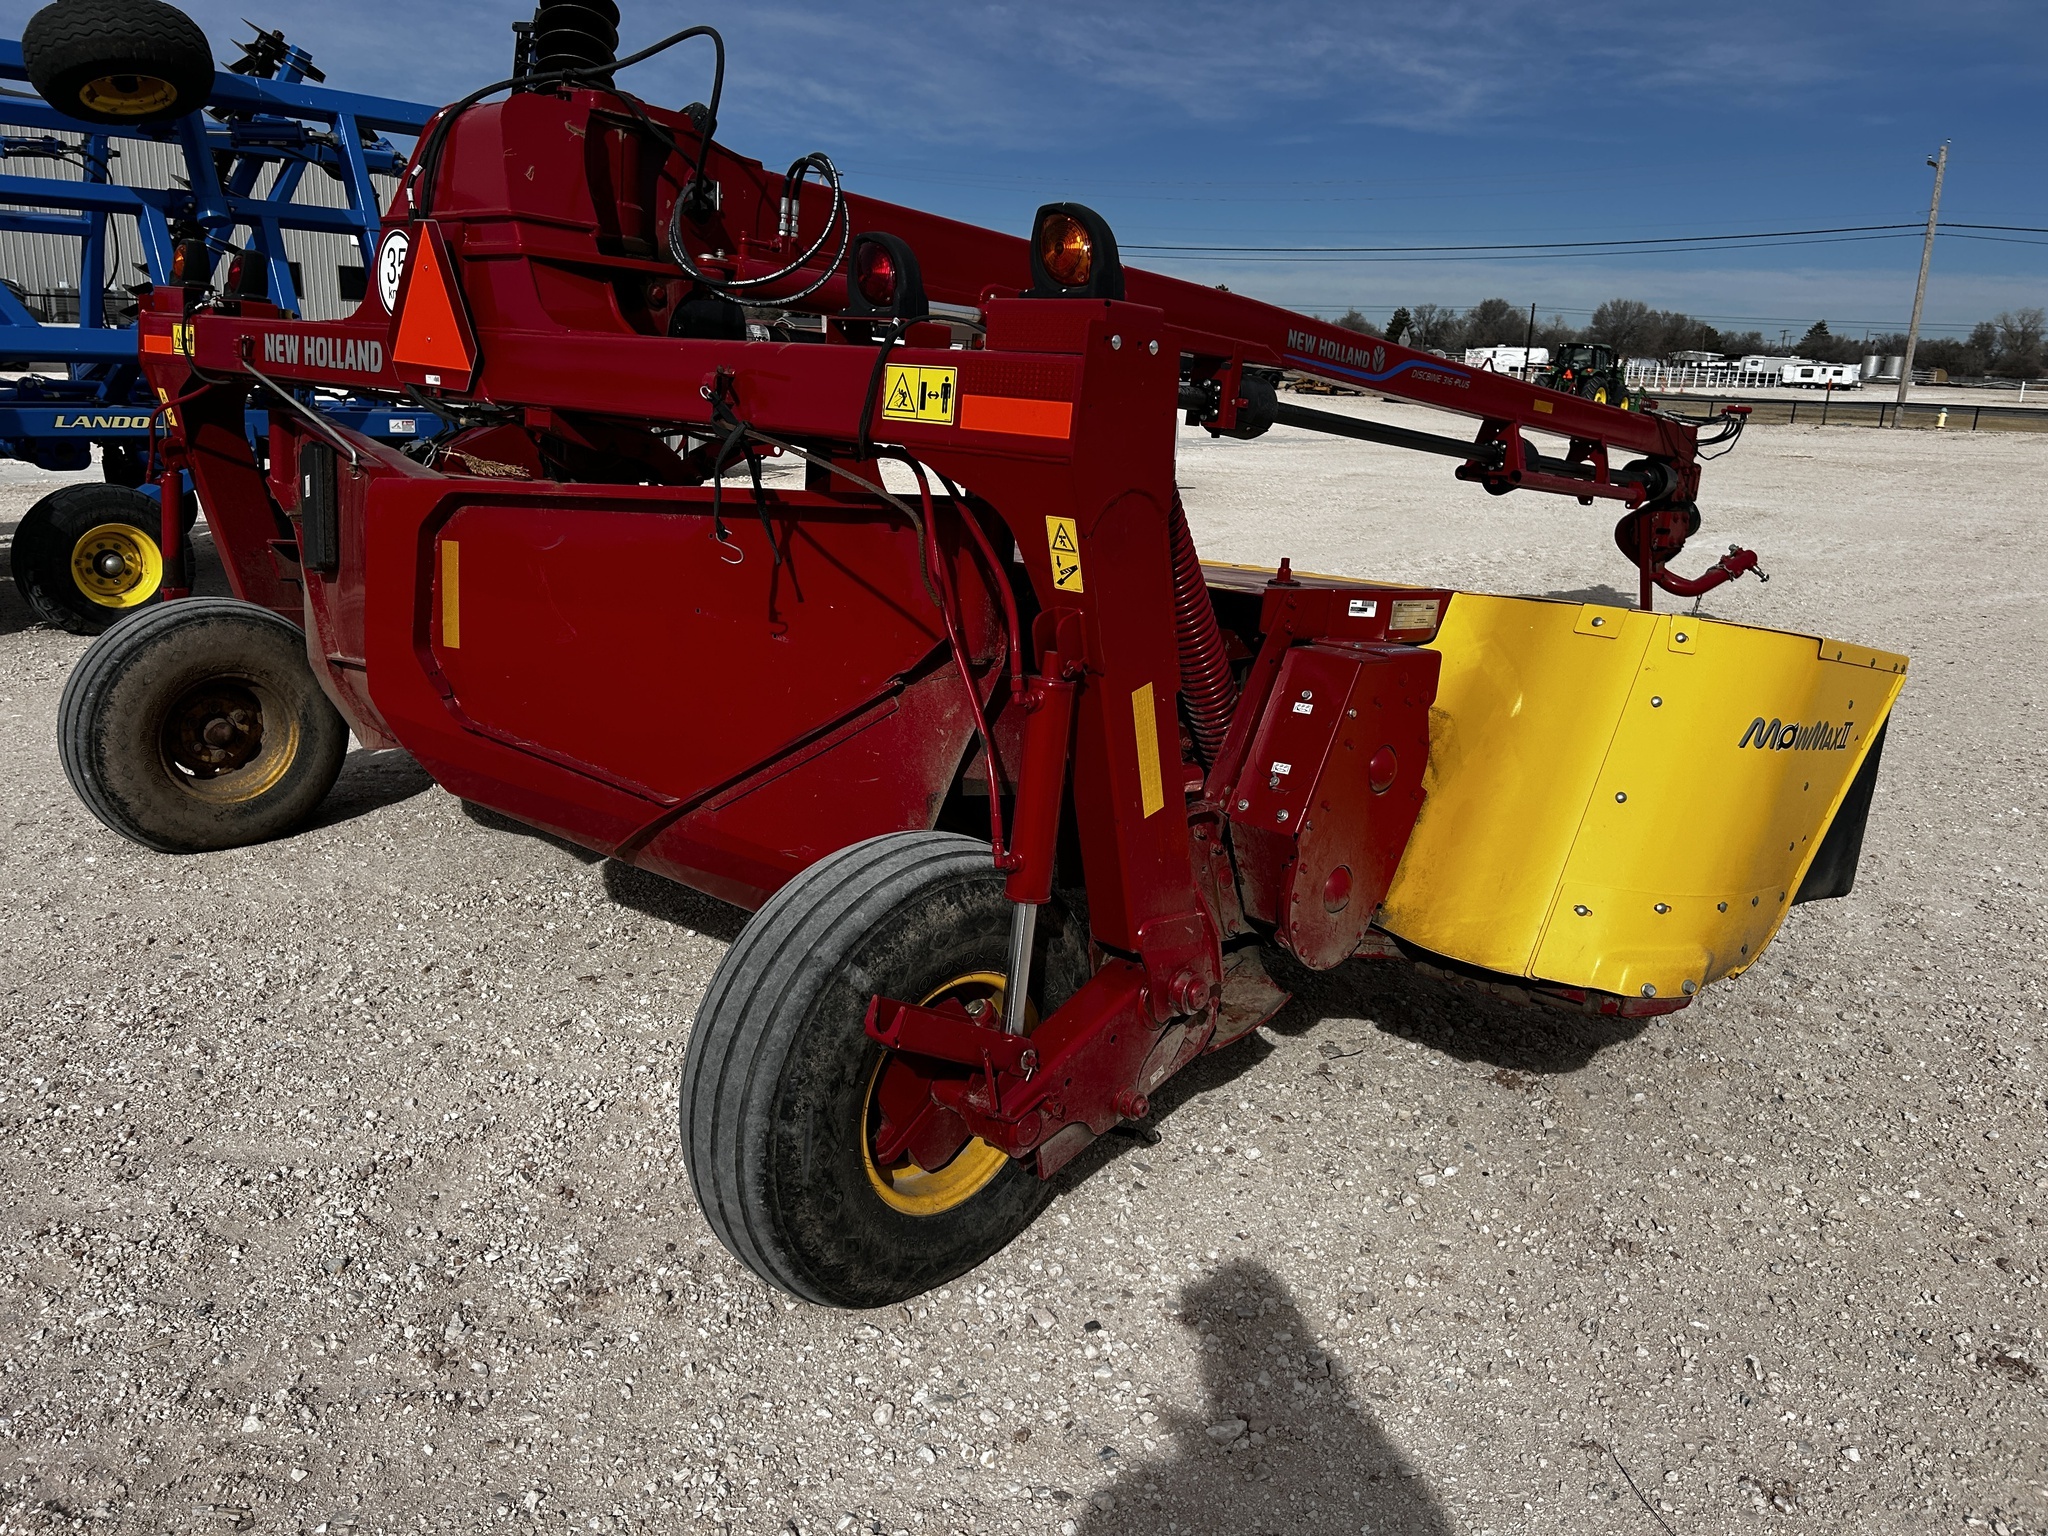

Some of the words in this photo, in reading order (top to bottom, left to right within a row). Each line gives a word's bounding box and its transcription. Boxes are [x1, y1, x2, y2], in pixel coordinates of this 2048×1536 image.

[264, 333, 300, 364] NEW
[303, 335, 383, 373] HOLLAND
[1287, 328, 1317, 354] NEW
[1318, 338, 1371, 369] HOLLAND
[1411, 369, 1442, 384] DISCBINE
[1442, 375, 1454, 386] 316
[1454, 378, 1471, 389] PLUS
